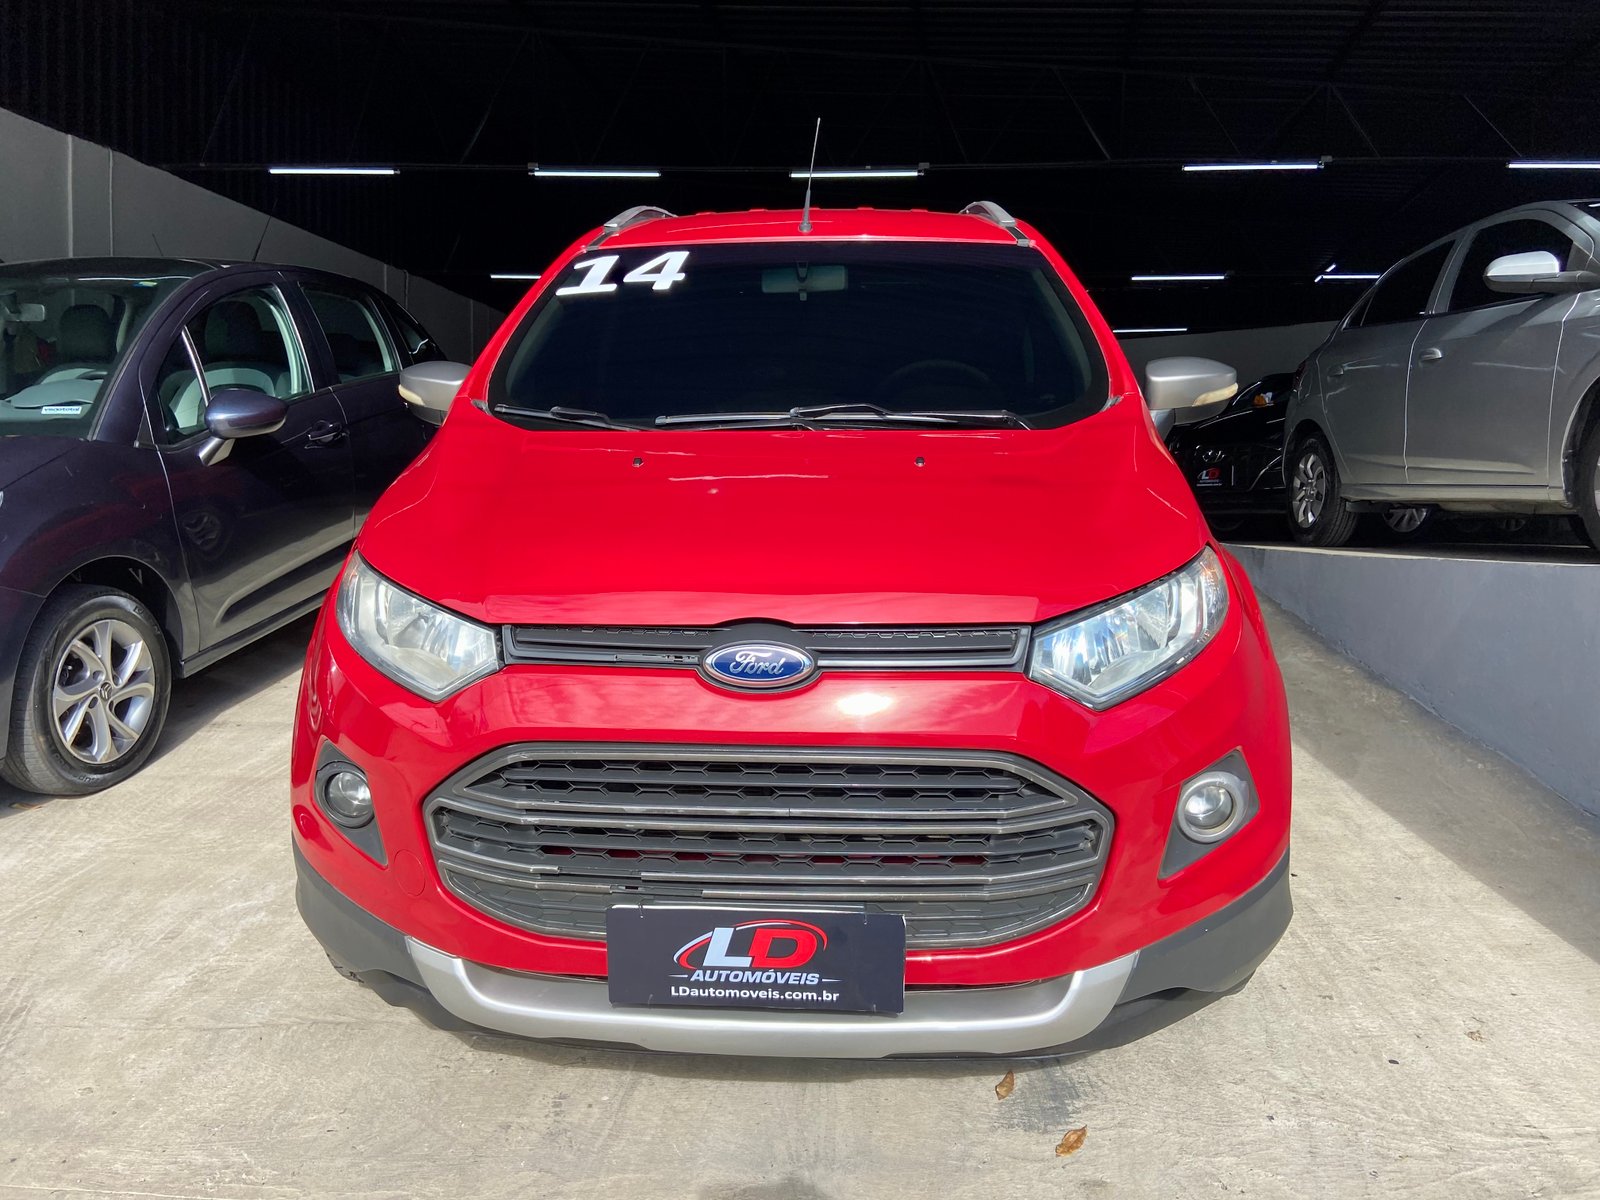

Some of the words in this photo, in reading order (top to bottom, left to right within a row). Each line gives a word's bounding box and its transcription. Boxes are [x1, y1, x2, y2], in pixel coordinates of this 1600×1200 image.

[556, 251, 689, 295] 14
[729, 651, 786, 675] Ford
[703, 927, 818, 968] LD
[690, 969, 820, 984] AUTOMÓVEIS
[671, 986, 839, 1001] LDautomoveis.com.br
